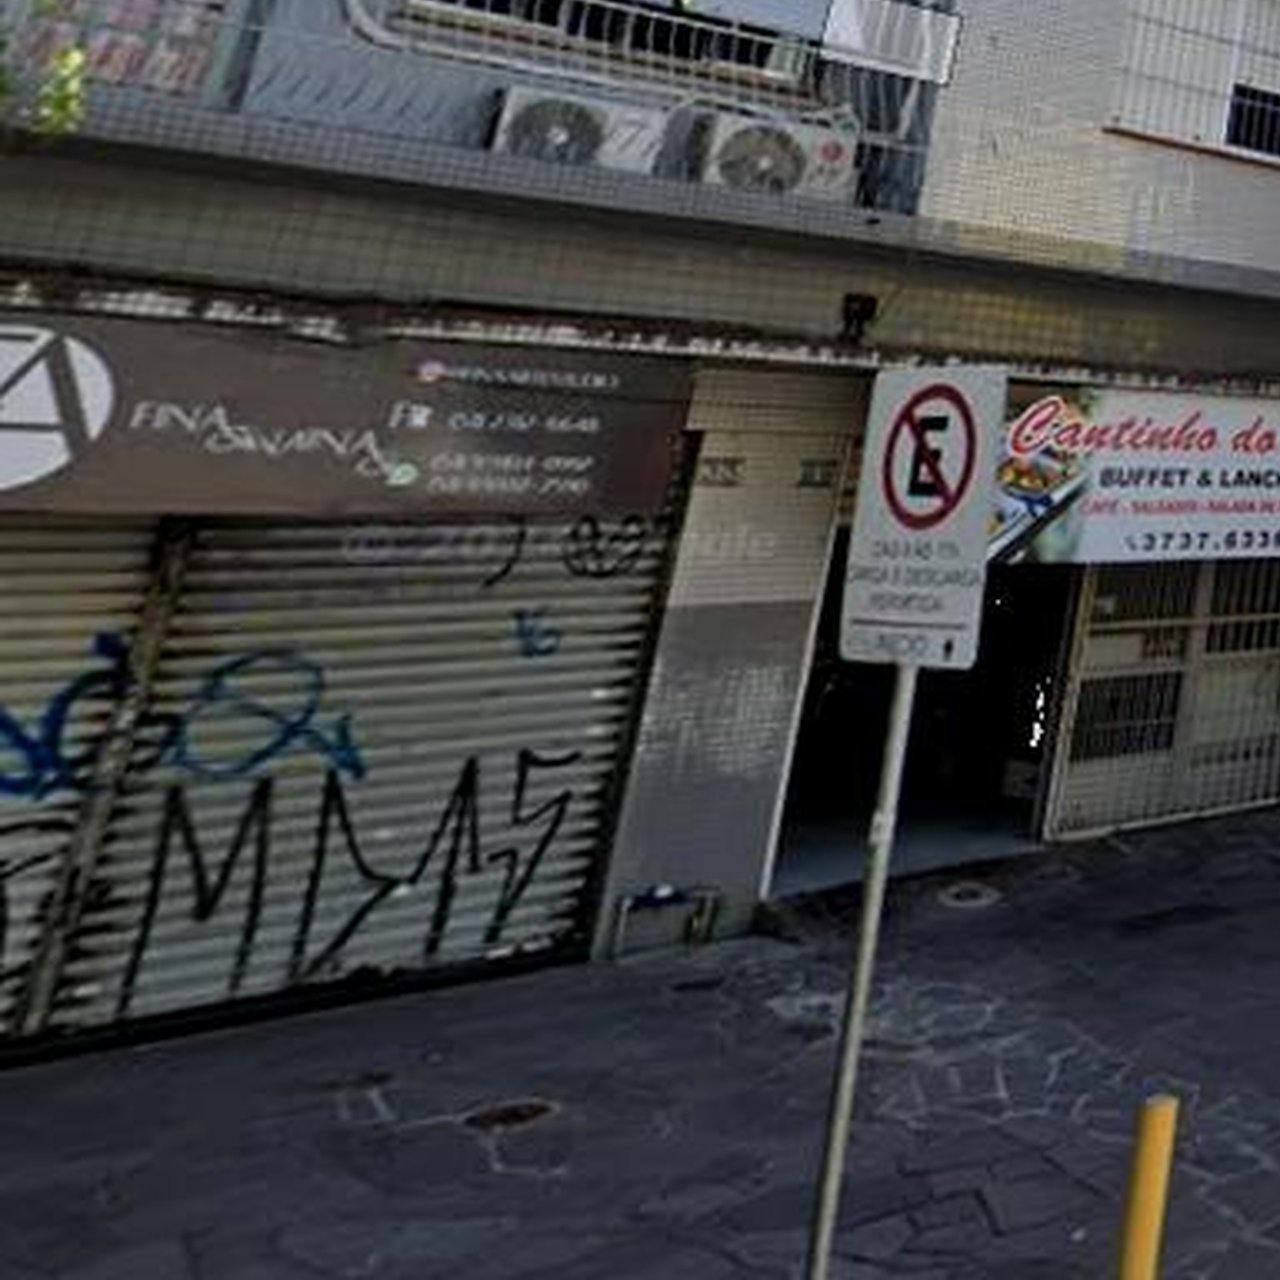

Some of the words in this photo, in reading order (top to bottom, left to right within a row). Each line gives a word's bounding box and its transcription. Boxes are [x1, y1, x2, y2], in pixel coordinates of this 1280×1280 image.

[1010, 397, 1217, 454] Cantinho
[1231, 415, 1276, 454] do
[1099, 466, 1191, 488] BUFFET
[1197, 469, 1212, 488] &
